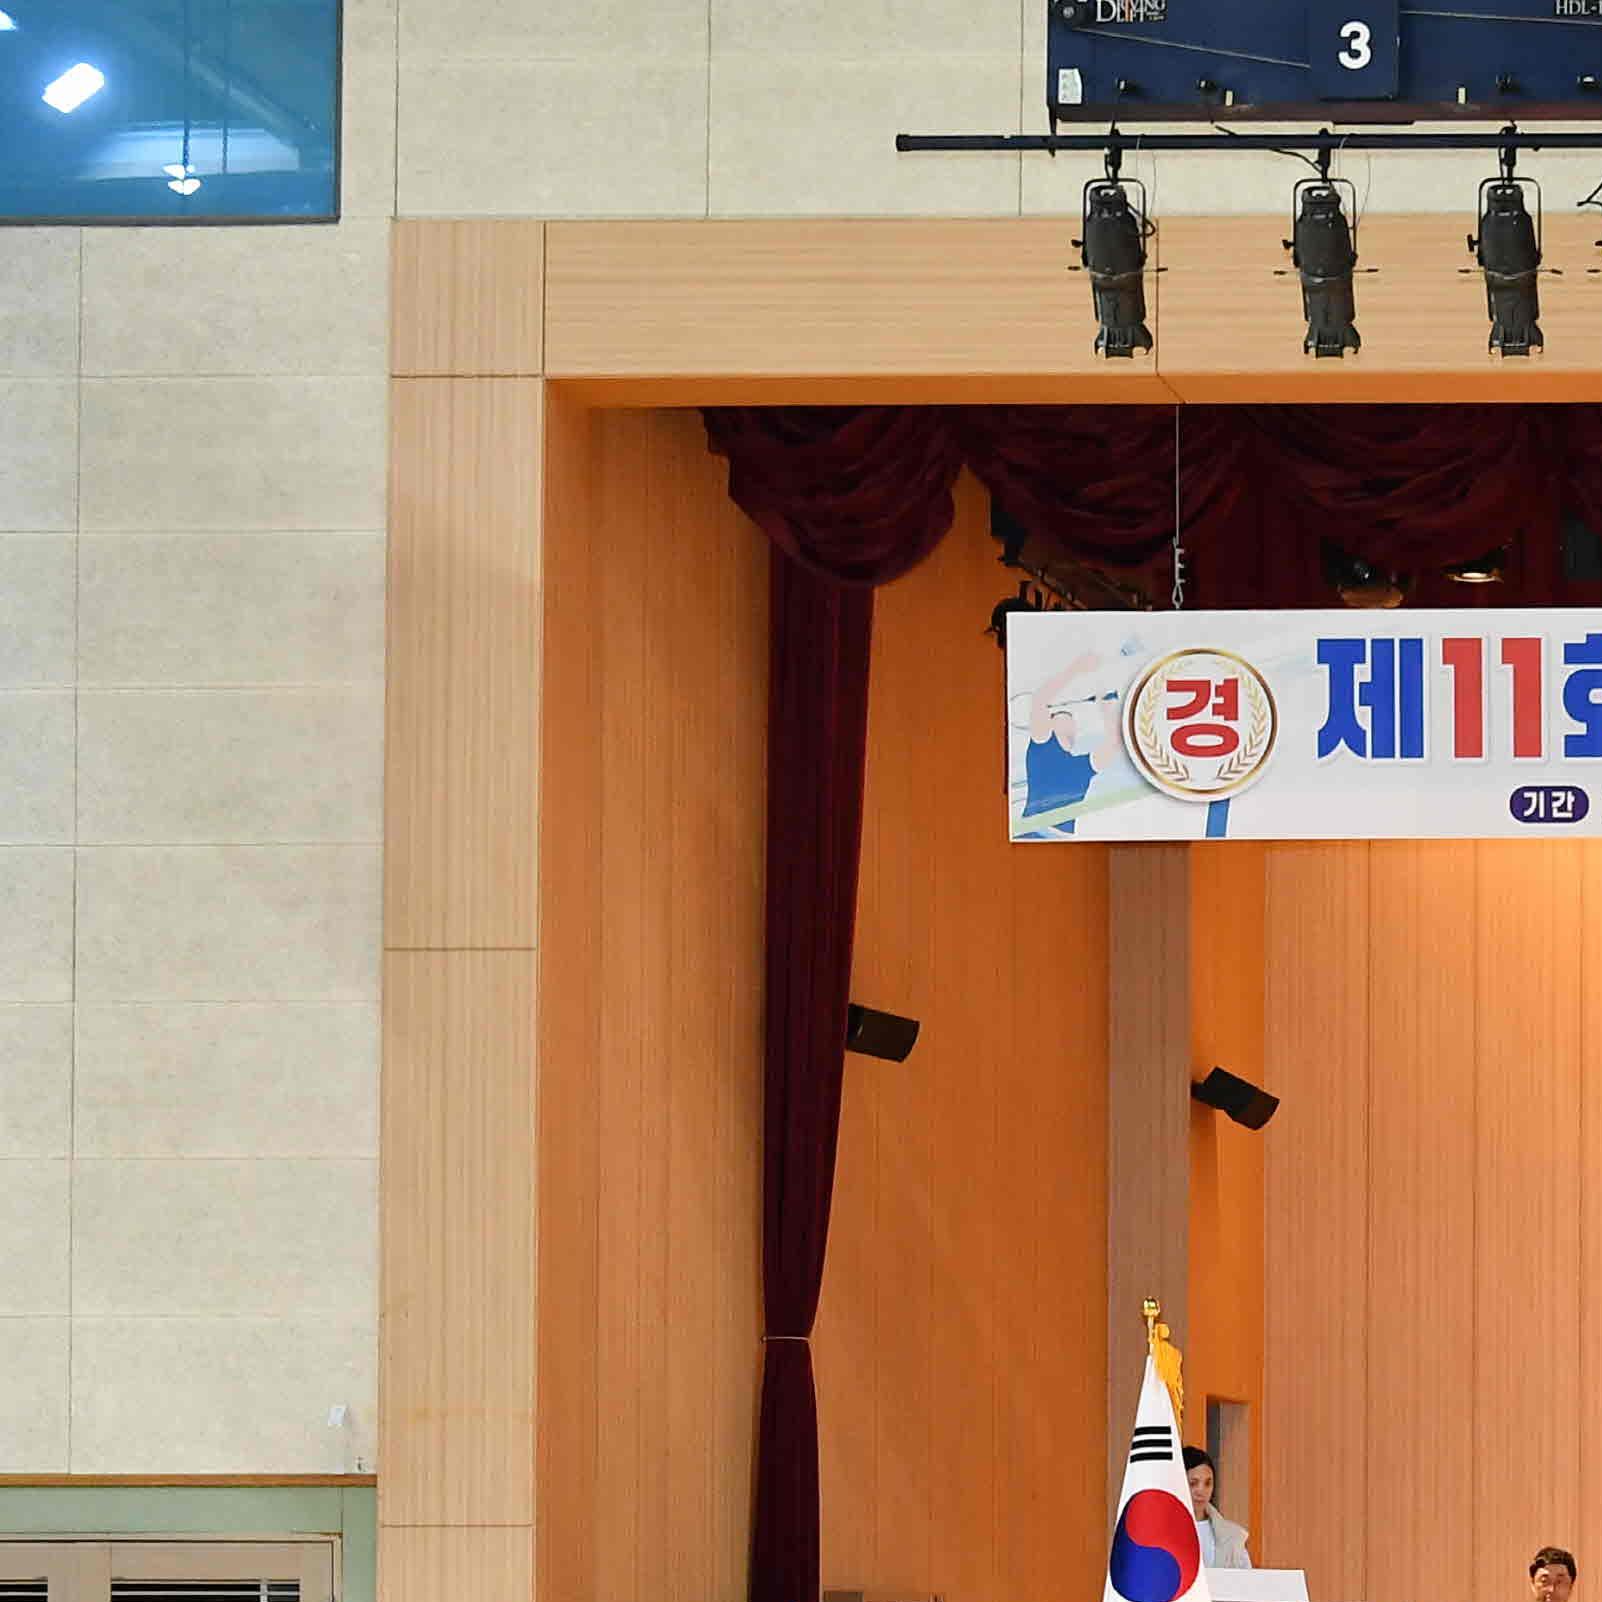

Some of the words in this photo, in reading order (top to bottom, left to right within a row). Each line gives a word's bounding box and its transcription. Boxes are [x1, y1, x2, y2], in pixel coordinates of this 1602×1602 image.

[1338, 21, 1371, 69] 3
[1166, 679, 1240, 759] 경
[1523, 791, 1576, 818] 기간
